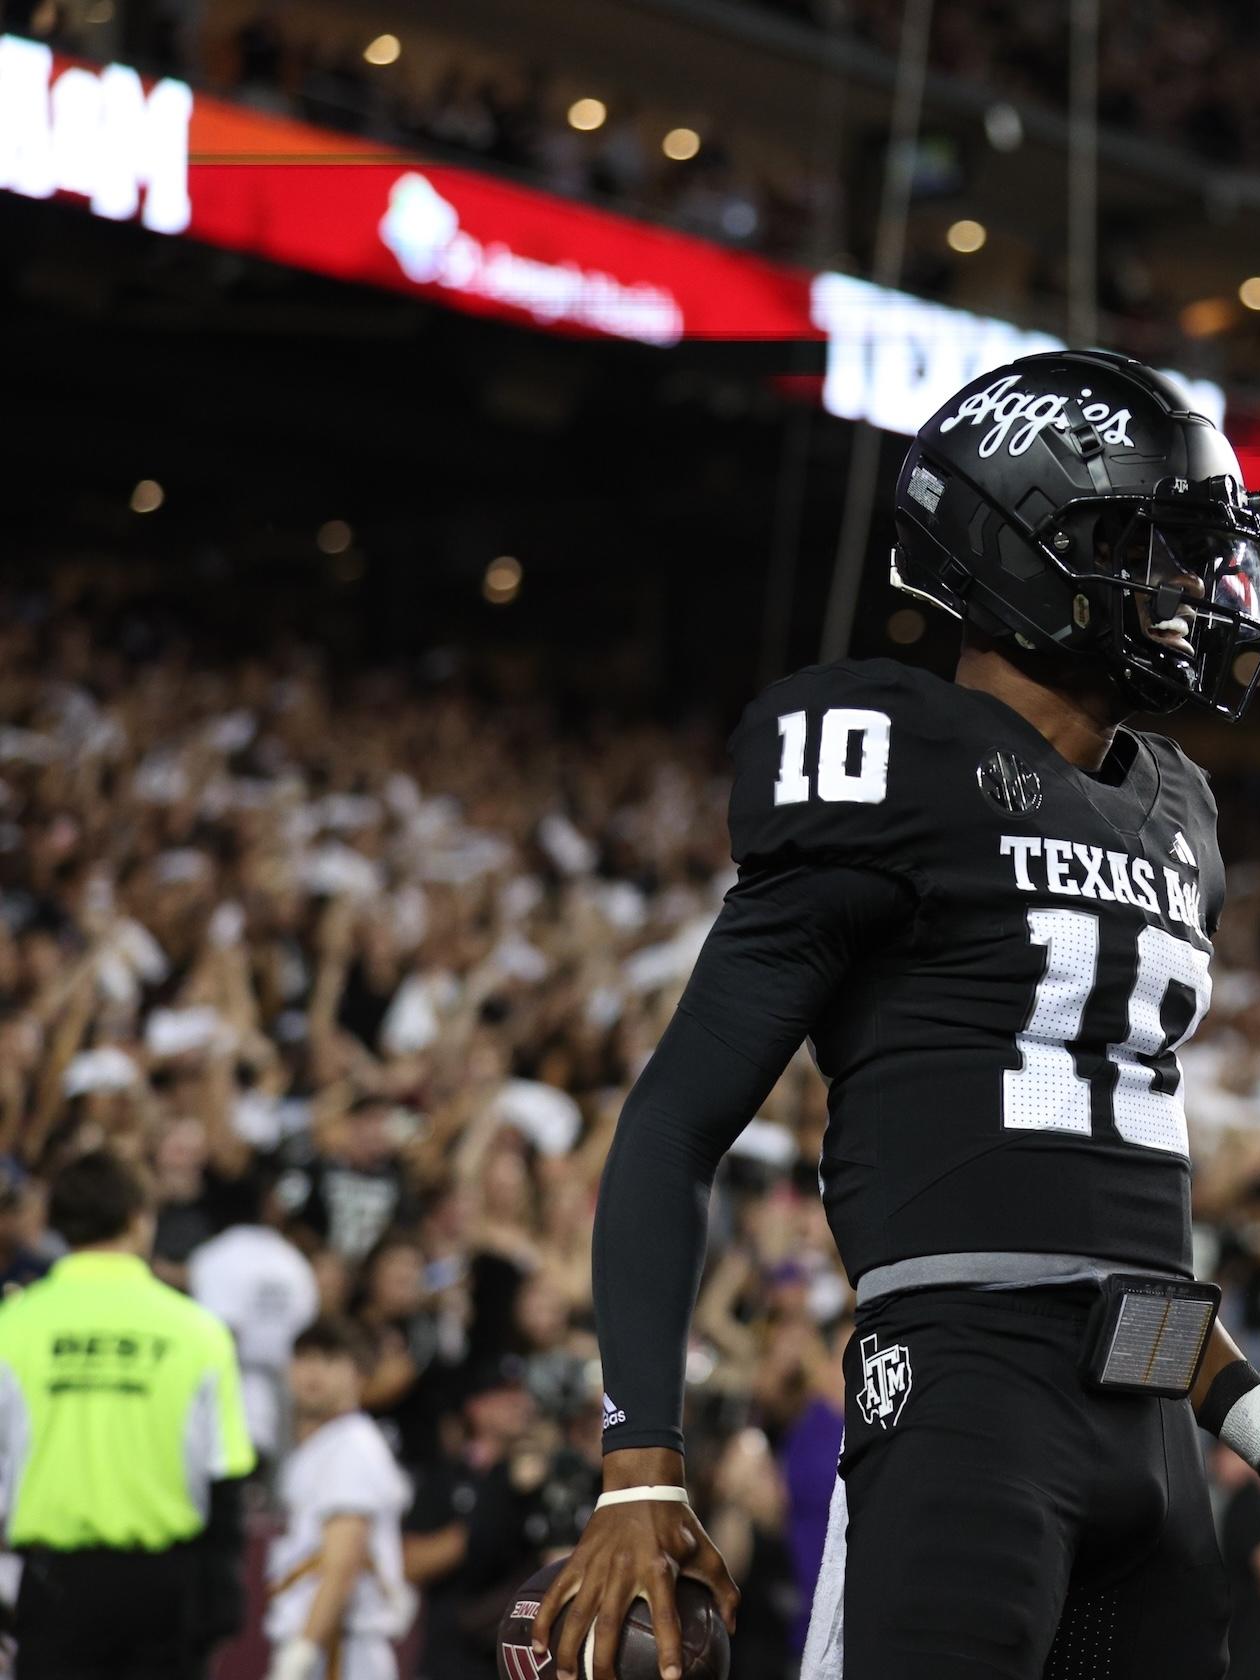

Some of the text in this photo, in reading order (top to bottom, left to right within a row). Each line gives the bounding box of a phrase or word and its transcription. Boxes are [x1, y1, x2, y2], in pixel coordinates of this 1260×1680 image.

[939, 374, 1135, 459] Aggies
[774, 708, 892, 807] 10
[1000, 835, 1161, 915] TEXAS
[1003, 907, 1213, 1157] 10
